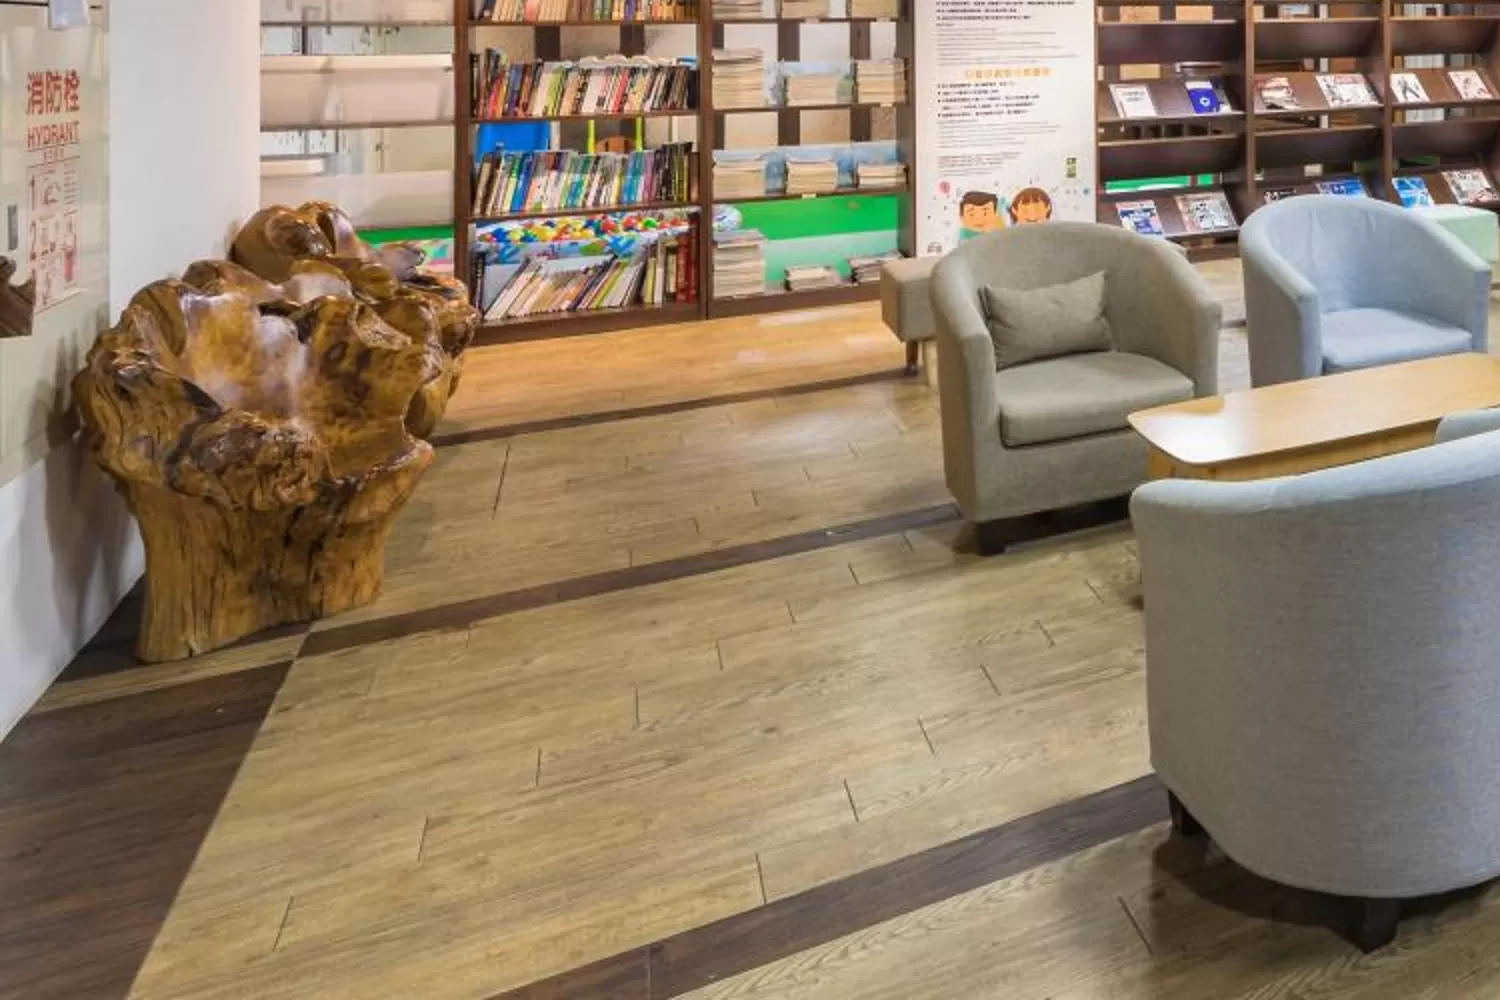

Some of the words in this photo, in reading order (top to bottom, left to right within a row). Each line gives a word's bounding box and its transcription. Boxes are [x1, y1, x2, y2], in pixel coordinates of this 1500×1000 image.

[26, 68, 80, 115] 消防栓
[27, 120, 80, 147] HYDRANT
